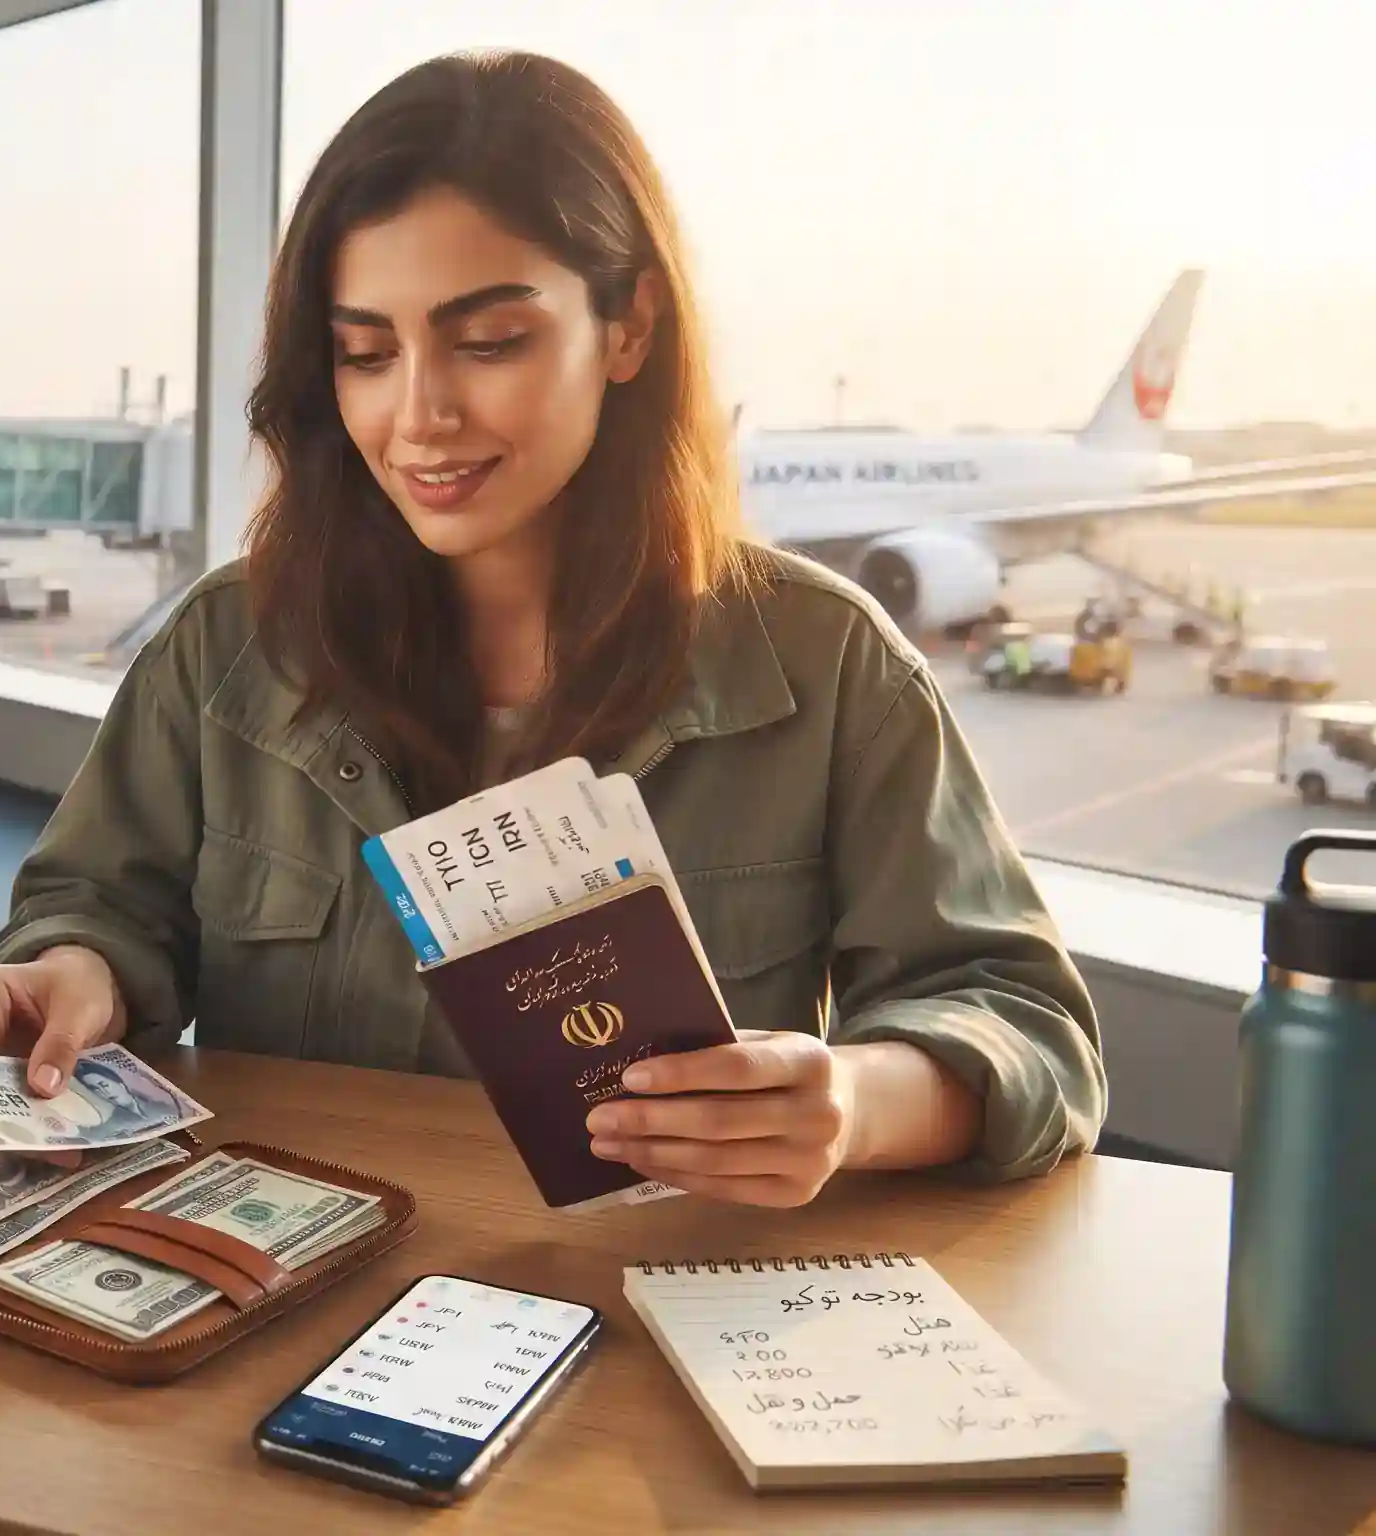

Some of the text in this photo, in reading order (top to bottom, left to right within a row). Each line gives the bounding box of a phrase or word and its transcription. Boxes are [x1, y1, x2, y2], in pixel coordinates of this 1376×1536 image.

[749, 461, 842, 483] JAPAN
[780, 1285, 924, 1313] بودجه توکیو
[904, 1316, 952, 1335] هتل
